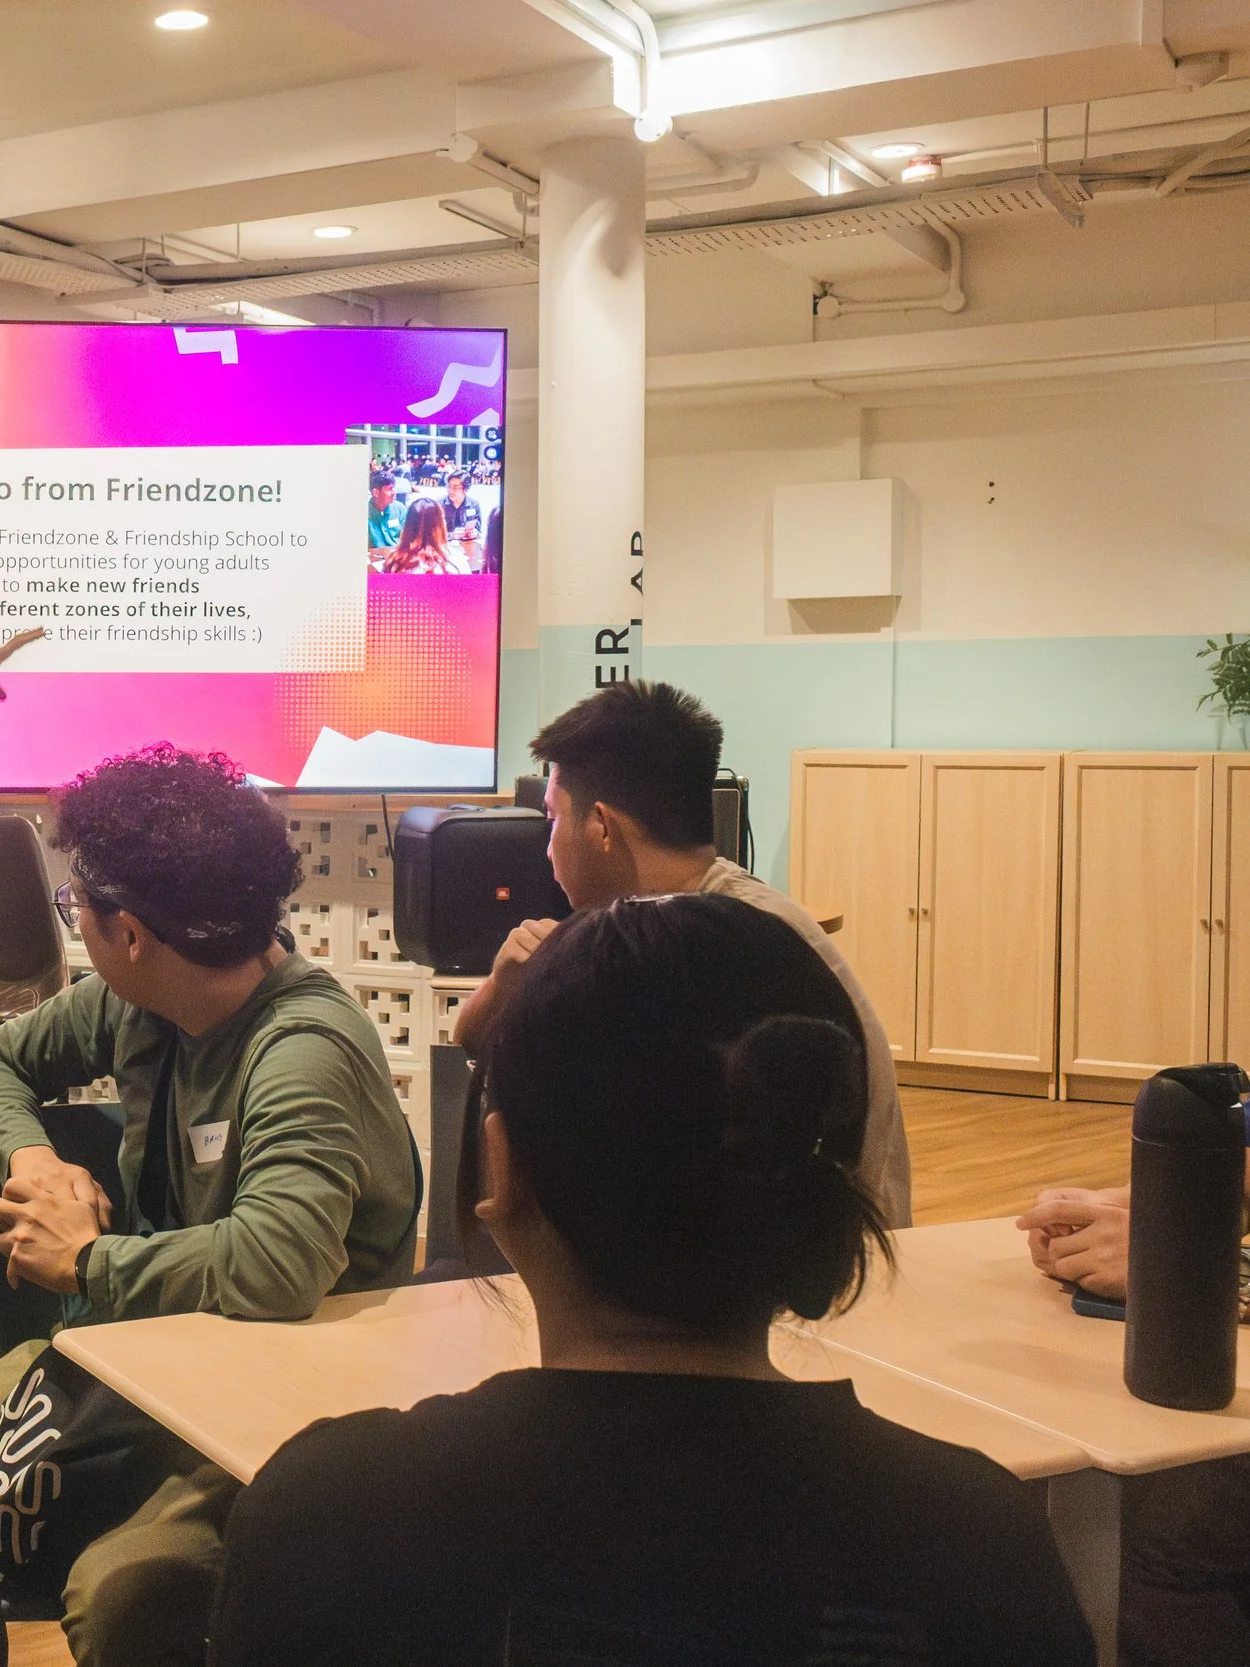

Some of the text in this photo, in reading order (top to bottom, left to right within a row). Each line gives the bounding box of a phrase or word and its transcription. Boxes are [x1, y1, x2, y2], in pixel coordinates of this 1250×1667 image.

[21, 475, 95, 502] from
[106, 476, 282, 503] Friendzone!
[105, 529, 119, 546] &
[125, 529, 220, 548] Friendship
[225, 530, 284, 547] School
[290, 532, 308, 547] to
[122, 552, 149, 570] for
[153, 557, 210, 574] young
[214, 553, 270, 571] adults
[2, 576, 200, 594] to make new friends
[64, 603, 121, 618] zones
[125, 600, 147, 618] of
[150, 600, 198, 618] their
[203, 601, 251, 620] lives,
[59, 624, 102, 641] their
[107, 624, 198, 644] friendship
[203, 624, 247, 642] skills
[252, 625, 263, 644] :)
